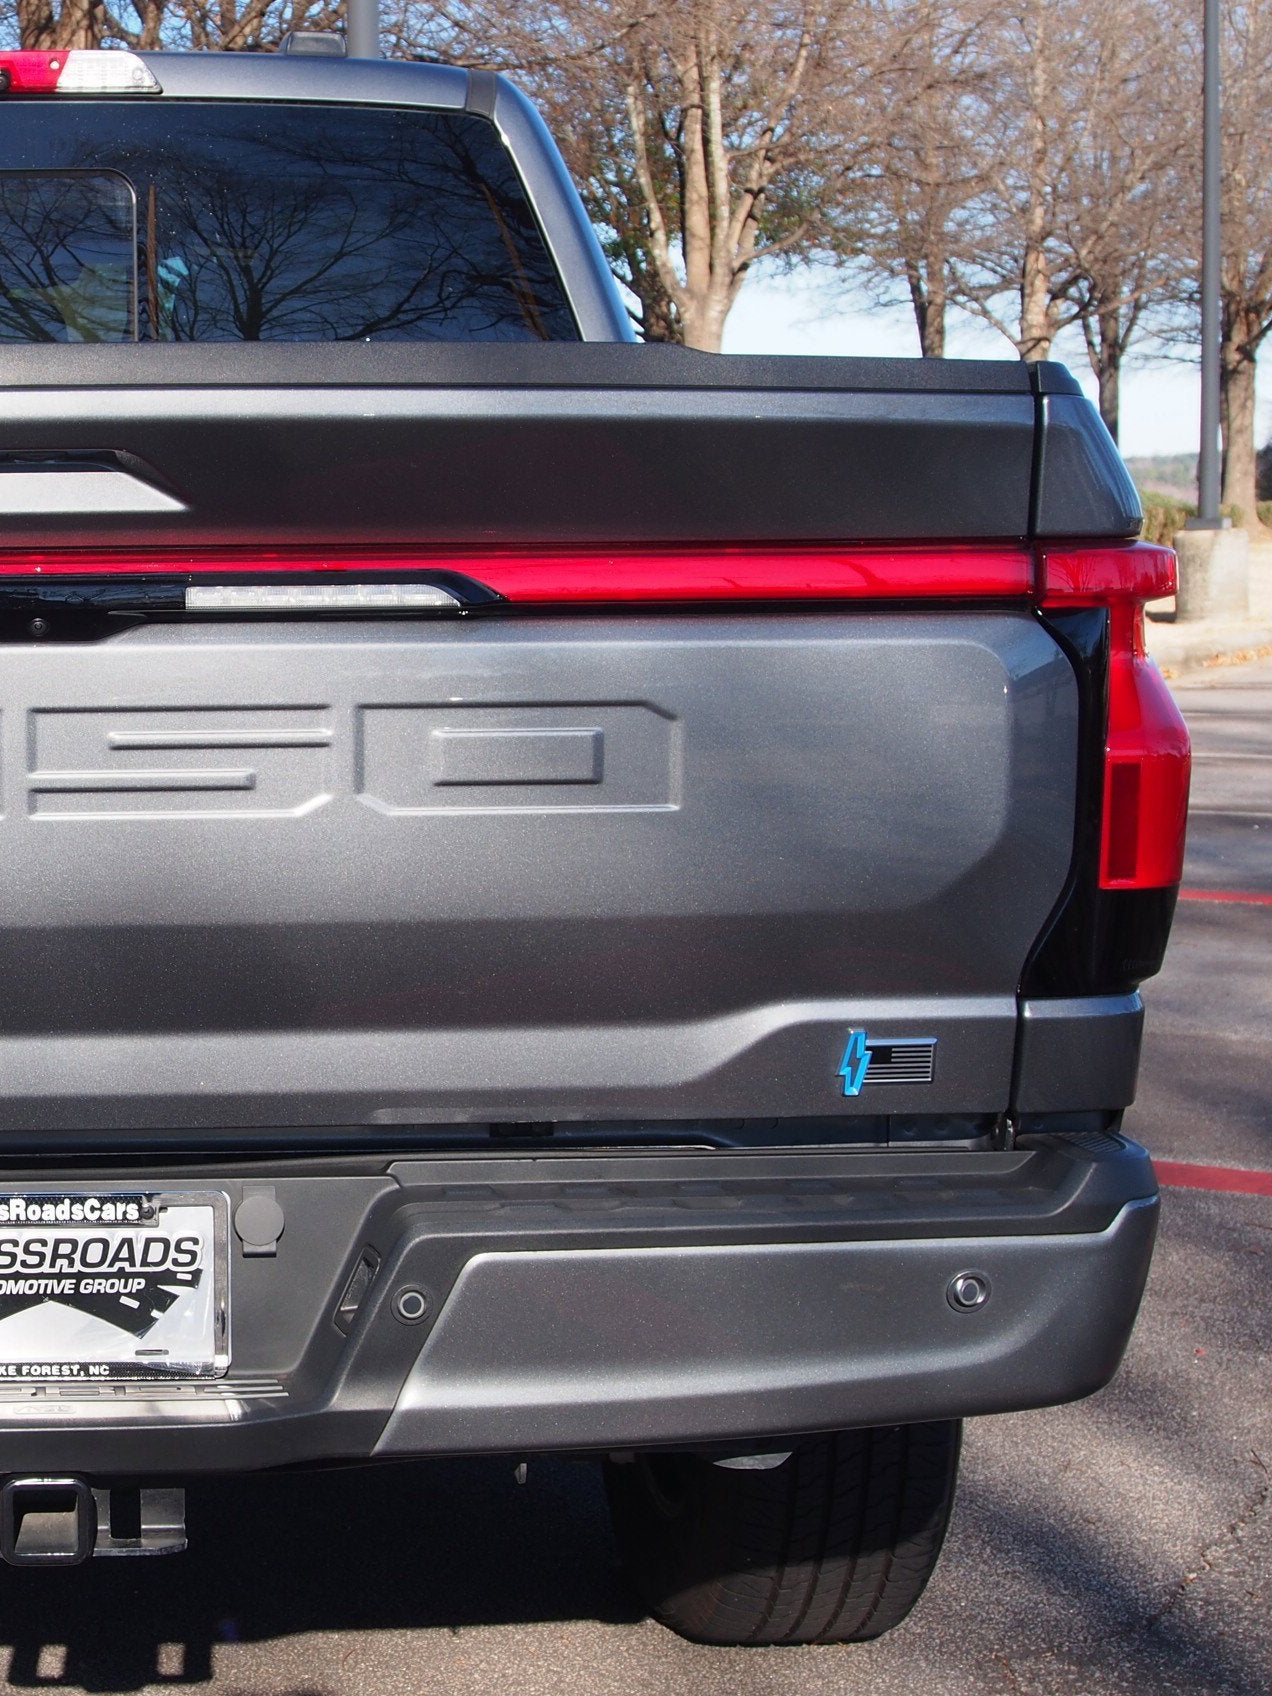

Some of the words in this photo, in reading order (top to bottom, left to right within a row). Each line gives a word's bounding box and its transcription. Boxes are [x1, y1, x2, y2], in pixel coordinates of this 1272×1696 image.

[79, 1278, 146, 1295] GROUP
[22, 1365, 85, 1378] FOREST,
[89, 1365, 110, 1377] NC
